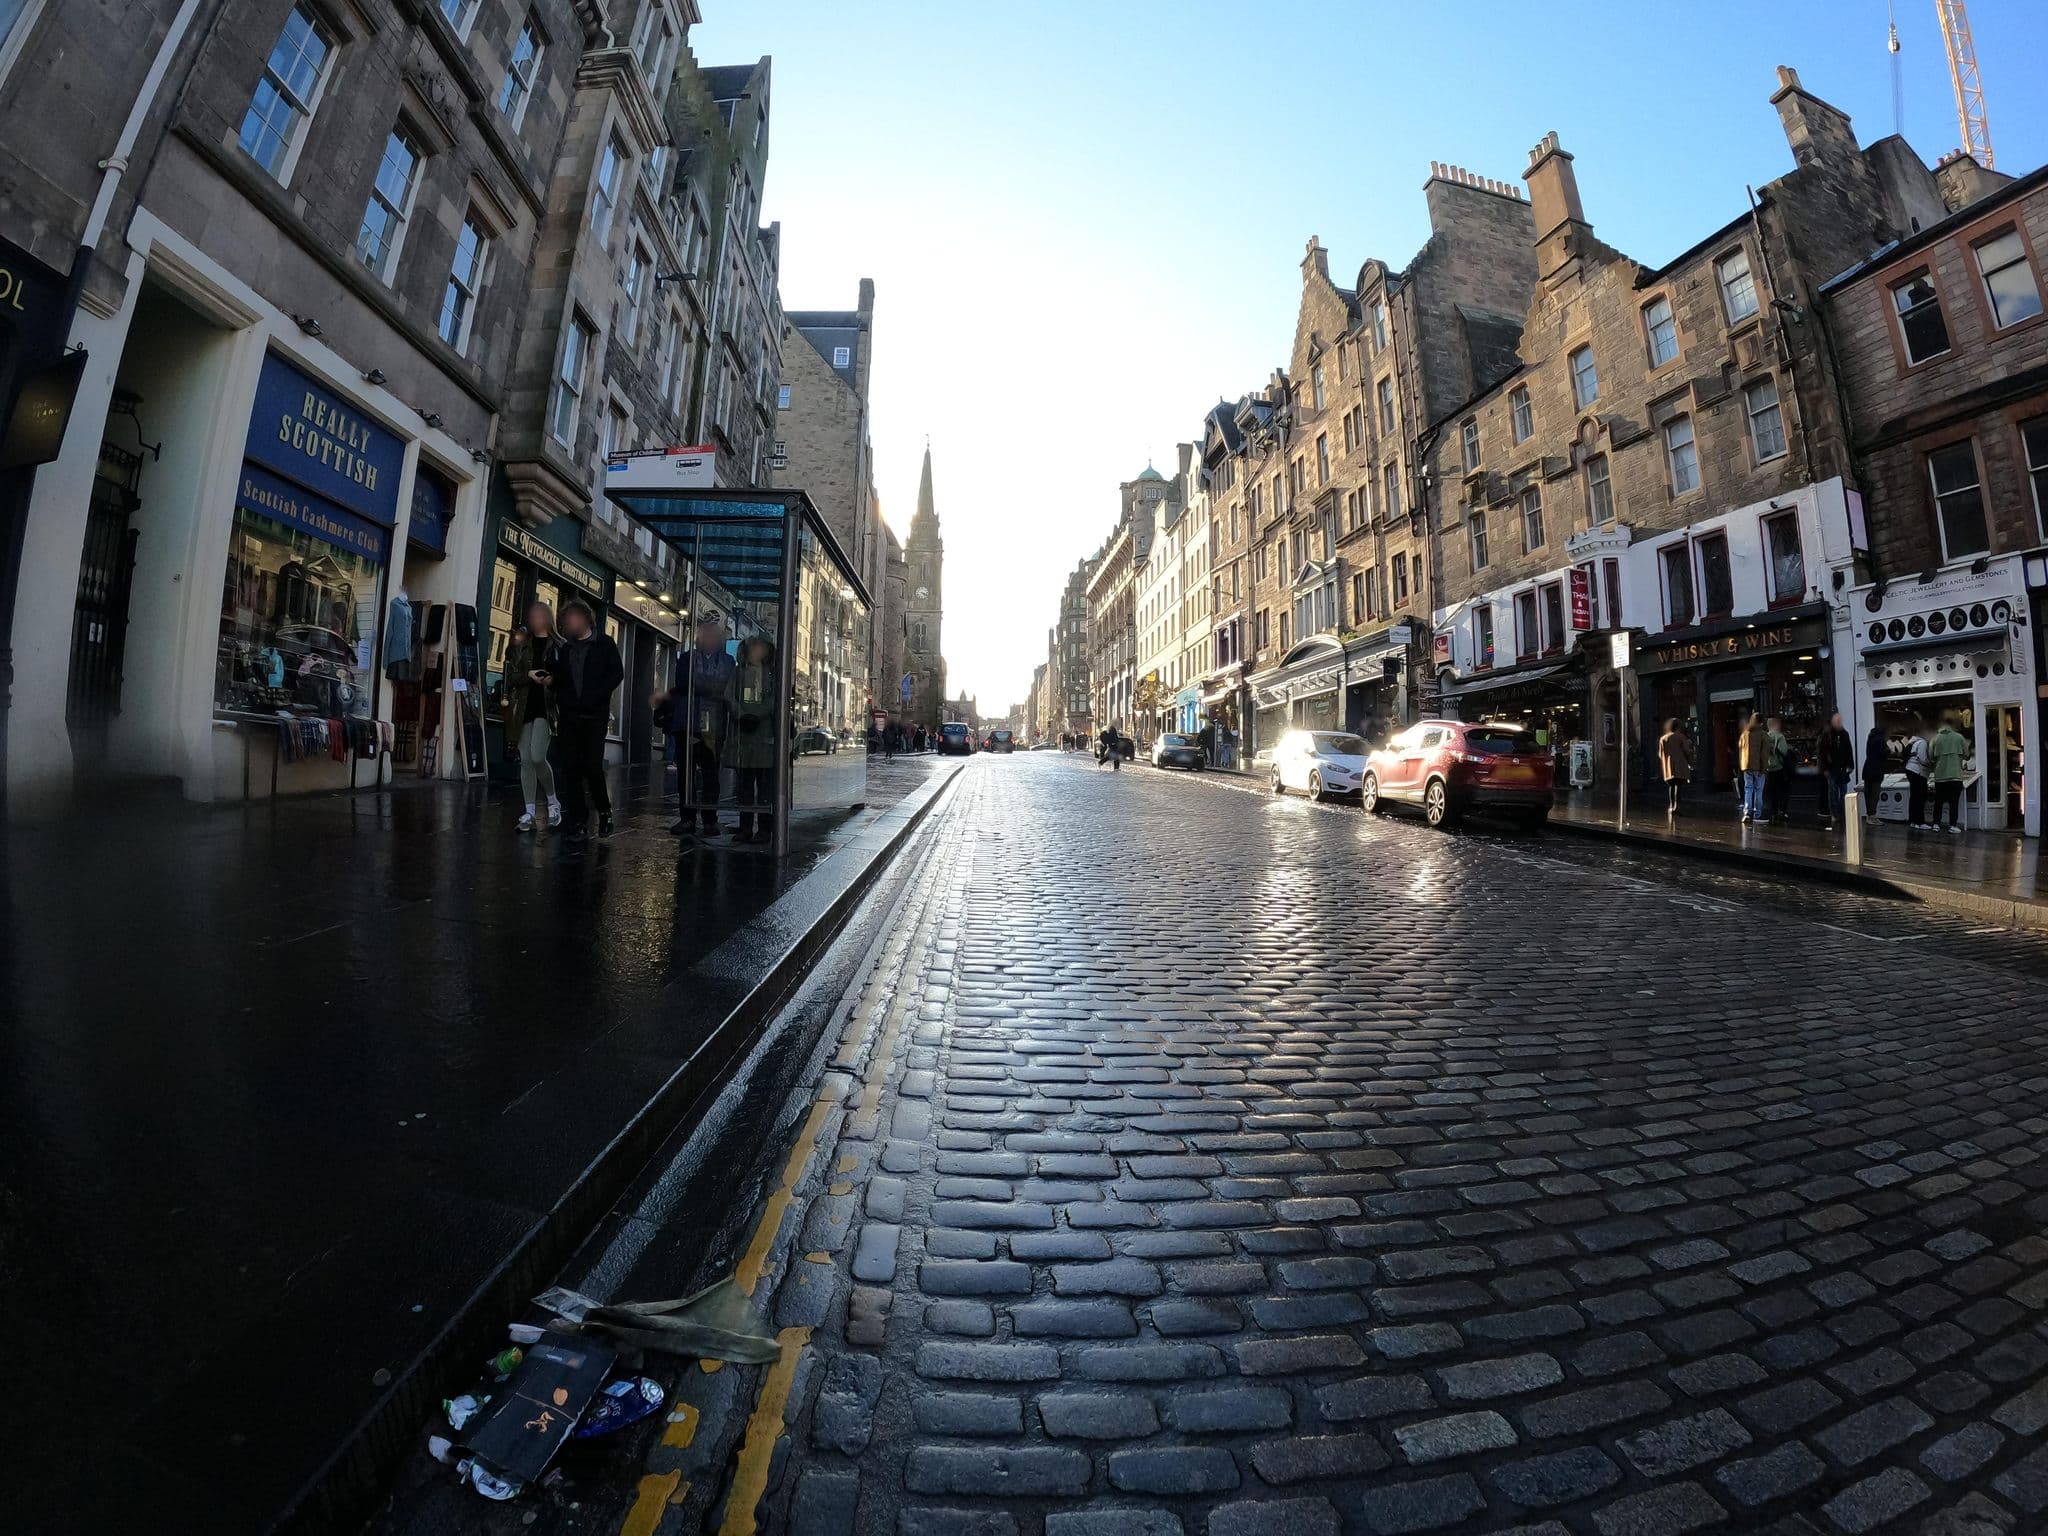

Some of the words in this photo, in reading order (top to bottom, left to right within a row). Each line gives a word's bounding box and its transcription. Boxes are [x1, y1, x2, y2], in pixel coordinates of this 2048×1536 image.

[278, 414, 379, 492] SCOTTISH
[301, 391, 371, 454] REALLY
[243, 479, 298, 518] Scottish
[301, 505, 354, 541] Cashmere
[356, 530, 380, 553] Club
[504, 526, 518, 545] THE
[561, 560, 588, 588] CHRISTMAS
[1886, 589, 1908, 598] CELTIC
[1910, 582, 1948, 595] JEWELLERY
[1949, 578, 1964, 586] AND
[1965, 569, 2009, 583] GEMSTONES
[1657, 640, 1720, 664] WHISKY
[1727, 637, 1739, 653] &
[1745, 628, 1793, 649] WINE
